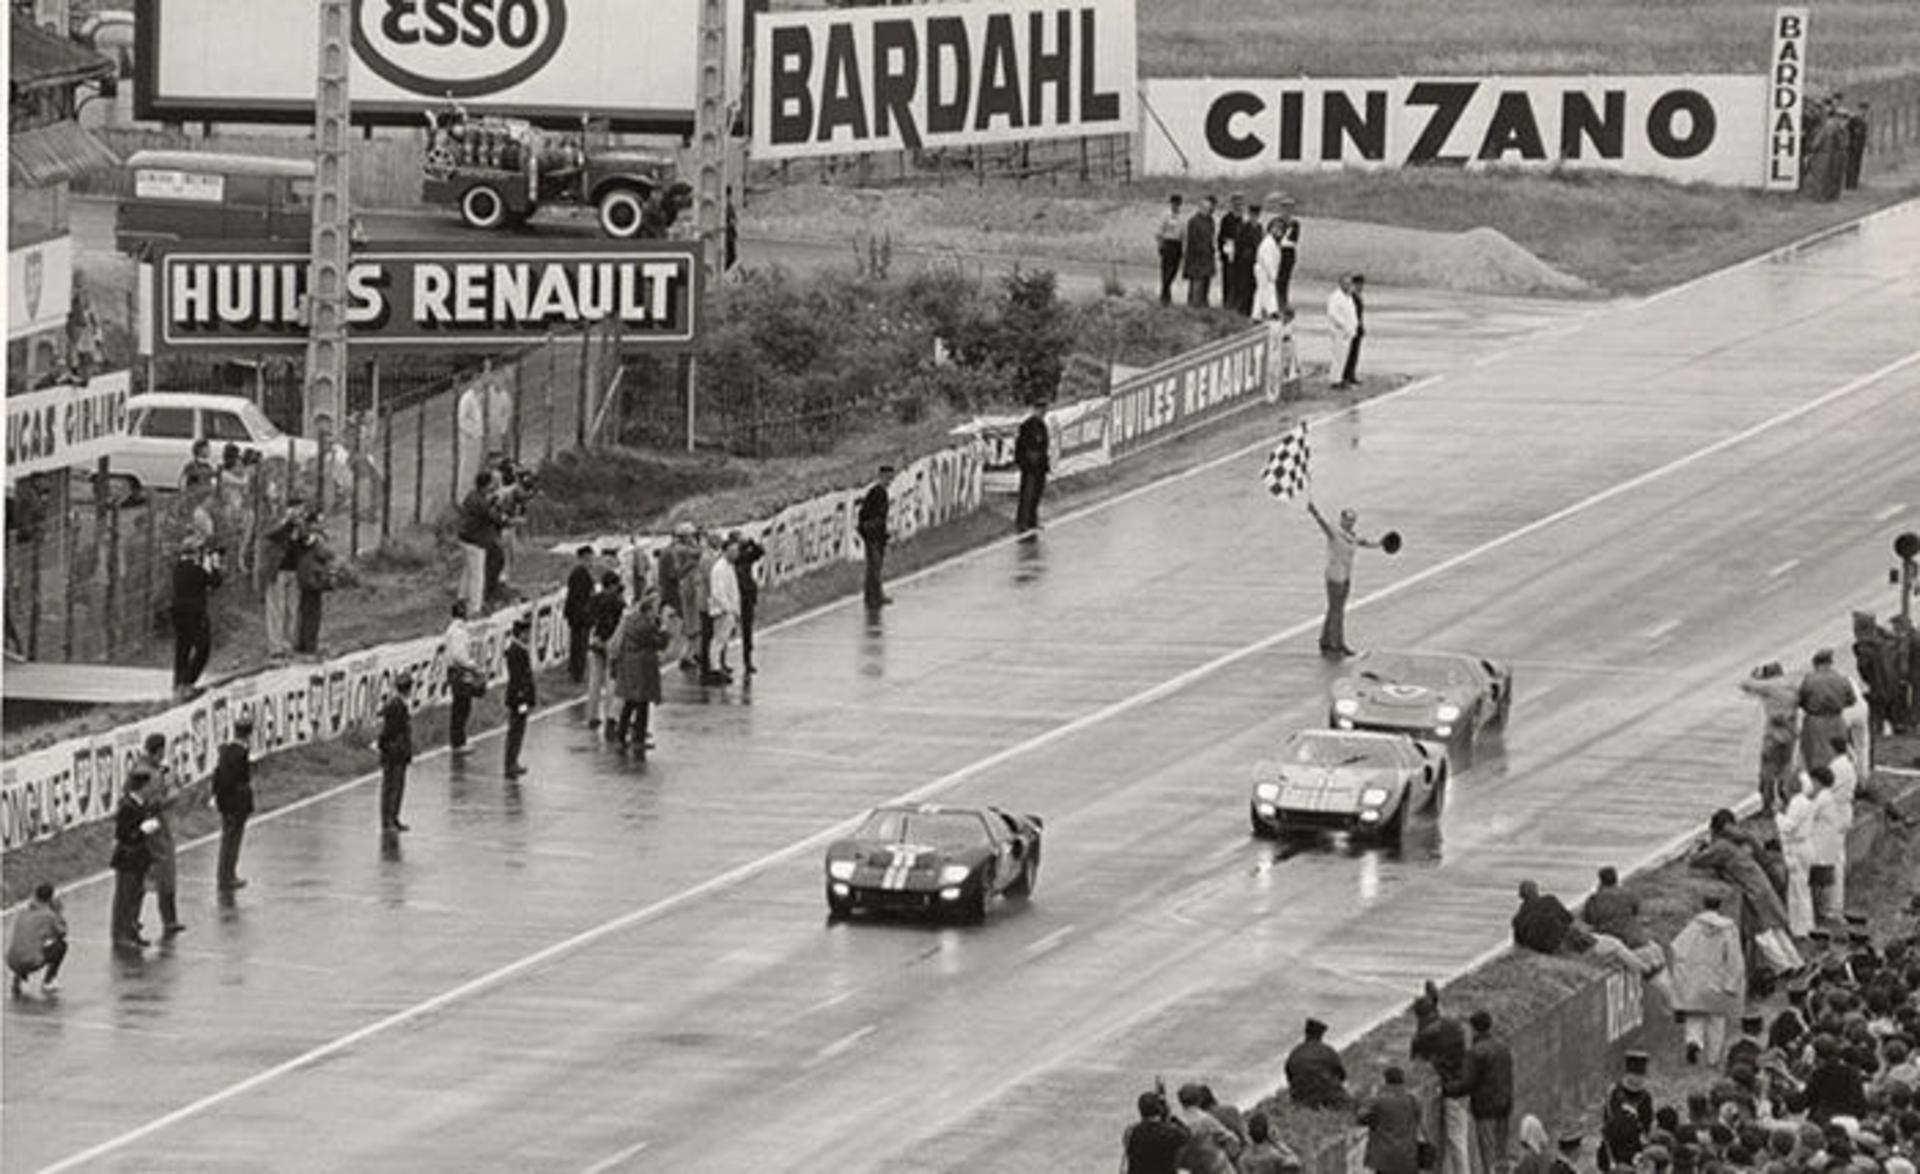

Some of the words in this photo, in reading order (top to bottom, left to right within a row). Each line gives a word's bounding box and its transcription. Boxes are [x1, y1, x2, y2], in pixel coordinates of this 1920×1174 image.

[770, 8, 1119, 150] BARDAHL
[1205, 82, 1717, 167] CINZANO
[1771, 15, 1801, 181] BARDAHL
[173, 264, 384, 322] HUILS
[413, 263, 678, 322] RENAULT
[1111, 377, 1177, 445] HUILES
[1184, 343, 1265, 416] RENAULT
